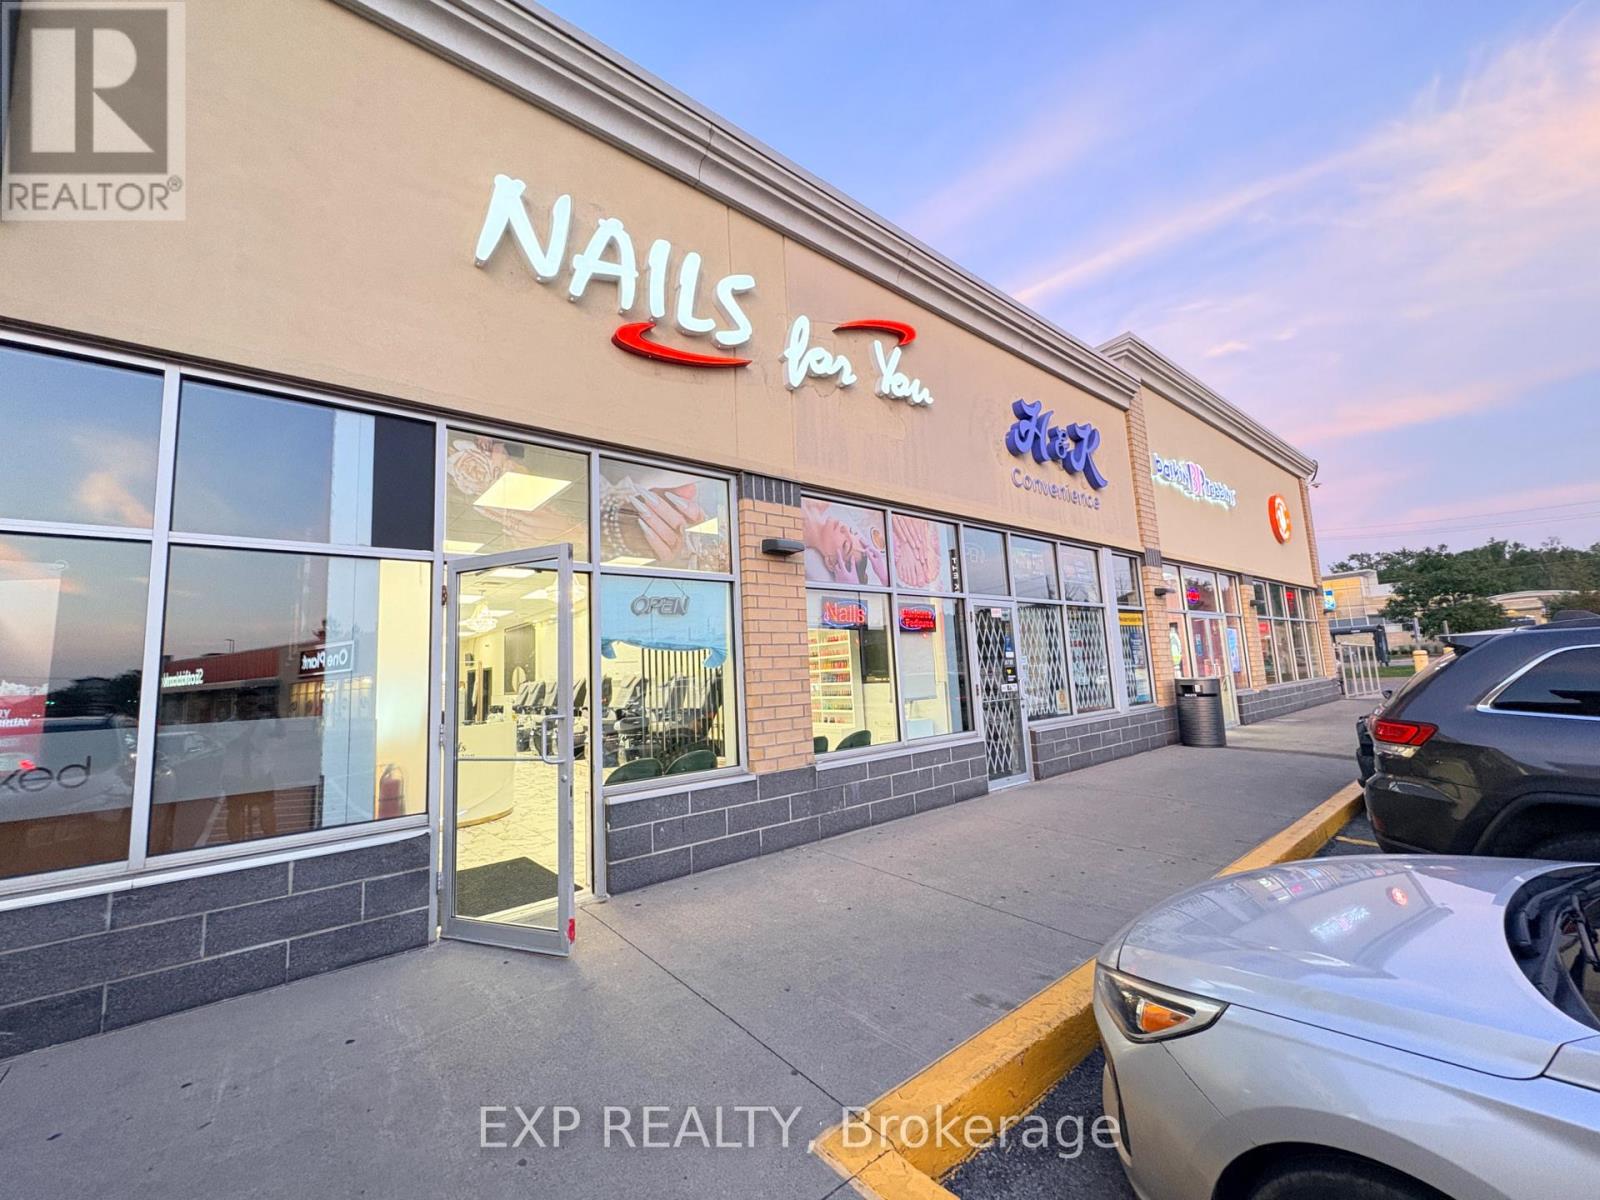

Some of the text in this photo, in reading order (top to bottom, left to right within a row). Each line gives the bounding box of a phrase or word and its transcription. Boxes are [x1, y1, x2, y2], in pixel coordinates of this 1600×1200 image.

[475, 174, 755, 349] NAILS
[783, 314, 934, 404] for You
[1011, 468, 1101, 510] Convenience
[630, 595, 690, 616] OPEN
[824, 601, 865, 623] Nails
